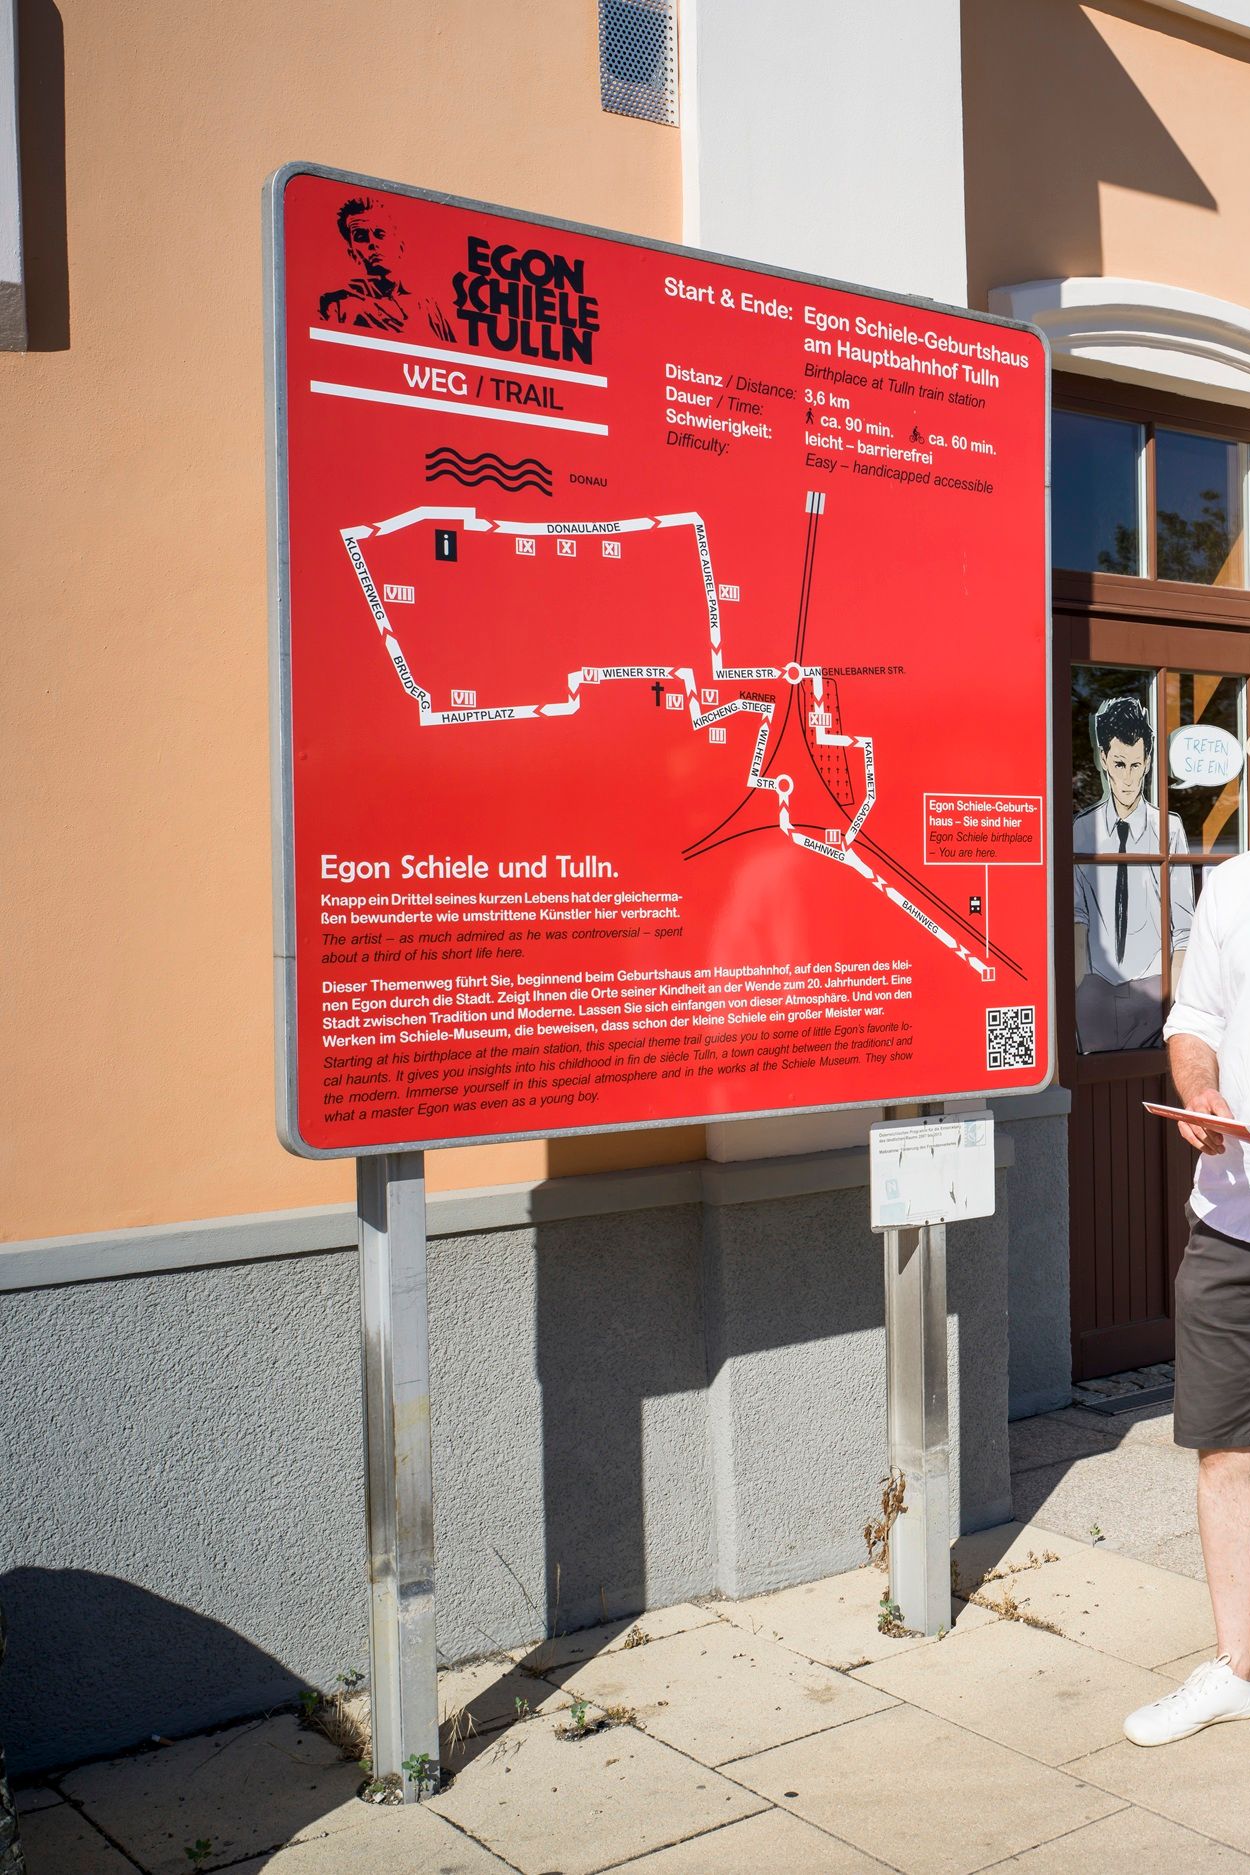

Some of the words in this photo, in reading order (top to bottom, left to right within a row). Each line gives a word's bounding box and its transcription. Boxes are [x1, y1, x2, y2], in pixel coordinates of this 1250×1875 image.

[468, 235, 584, 293] EGON
[452, 271, 600, 332] SCHIELE
[664, 276, 715, 304] Start
[720, 288, 735, 308] &
[741, 292, 792, 320] Ende:
[457, 308, 592, 366] TULLN
[804, 305, 849, 331] Egon
[855, 316, 1029, 368] Schiele-Geburtshaus
[803, 337, 831, 355] am
[837, 340, 959, 379] Hauptbahnhof
[961, 364, 999, 388] Tulln
[403, 363, 468, 396] WEG
[490, 378, 564, 410] TRAIL
[665, 363, 723, 387] Distanz
[735, 376, 796, 399] Distance:
[804, 362, 867, 387] Birthplace
[871, 377, 883, 390] at
[888, 378, 915, 396] Tulln
[918, 385, 944, 401] train
[947, 391, 985, 408] station
[666, 385, 713, 407] Dauer
[728, 396, 762, 415] Time:
[804, 388, 825, 406] 3,6
[829, 392, 850, 409] km
[666, 408, 772, 439] Schwierigkeit:
[820, 415, 841, 429] ca.
[845, 416, 862, 432] 90
[866, 422, 893, 438] min.
[666, 430, 729, 456] Difficulty:
[805, 431, 843, 450] leicht
[857, 439, 932, 464] barrierefrei
[928, 434, 947, 447] ca.
[951, 435, 967, 450] 60
[970, 440, 996, 455] min.
[569, 473, 608, 488] DONAU
[805, 452, 837, 473] Easy
[853, 460, 931, 484] handicapped
[933, 475, 993, 494] accessible
[344, 536, 385, 621] KLOSTERWEG
[602, 668, 643, 678] WIENER
[646, 667, 669, 678] STR.
[716, 669, 753, 679] WIENER
[756, 669, 777, 678] STR.
[887, 666, 906, 675] STR.
[739, 690, 776, 703] KARNER
[741, 701, 772, 714] STIEGE
[441, 709, 515, 724] HAUPTPLATZ
[693, 702, 740, 729] KIRCHENG.
[751, 729, 769, 777] WILHELM
[1184, 737, 1230, 757] TRETEN
[1184, 757, 1204, 773] SIE
[1207, 759, 1229, 777] EIN!
[756, 779, 777, 790] STR.
[929, 799, 954, 813] Egon
[956, 800, 1037, 812] Schiele-Geburts-
[929, 815, 953, 826] haus
[963, 815, 978, 826] Sie
[980, 816, 1000, 827] sind
[1003, 817, 1022, 827] hier
[804, 837, 846, 862] BAHNWEG
[929, 831, 953, 844] Egon
[956, 831, 988, 842] Schiele
[990, 832, 1032, 844] birthplace
[939, 847, 956, 857] You
[958, 849, 973, 857] are
[975, 847, 998, 858] here.
[321, 854, 390, 883] Egon
[401, 854, 489, 879] Schiele
[498, 854, 546, 878] und
[555, 855, 618, 878] Tulln.
[321, 894, 366, 908] Knapp
[368, 893, 389, 905] ein
[391, 893, 432, 905] Drittel
[434, 893, 477, 905] seines
[479, 892, 522, 904] kurzen
[524, 892, 569, 903] Lebens
[571, 892, 591, 903] hat
[591, 891, 613, 903] der
[613, 891, 682, 905] gleicherma-
[321, 912, 346, 924] ßen
[350, 911, 433, 924] bewunderte
[436, 910, 459, 922] wie
[463, 909, 536, 921] umstrittene
[540, 908, 592, 920] Künstler
[594, 908, 618, 919] hier
[620, 907, 680, 918] verbracht.
[902, 899, 939, 935] BAHNWEG
[321, 933, 346, 945] The
[350, 933, 382, 945] artist
[399, 934, 414, 944] as
[418, 931, 452, 943] much
[456, 930, 505, 942] admired
[508, 931, 522, 941] as
[526, 929, 541, 940] he
[545, 931, 567, 940] was
[572, 927, 640, 939] controversial
[654, 926, 684, 939] spent
[321, 951, 358, 964] about
[361, 953, 369, 962] a
[373, 950, 401, 962] third
[404, 949, 417, 961] of
[420, 949, 437, 960] his
[441, 948, 472, 960] short
[475, 947, 492, 958] life
[496, 947, 525, 957] here.
[322, 981, 367, 993] Dieser
[370, 979, 452, 991] Themenweg
[455, 975, 488, 987] führt
[490, 974, 514, 987] Sie,
[517, 972, 582, 987] beginnend
[585, 971, 614, 982] beim
[617, 968, 691, 981] Geburtshaus
[694, 969, 711, 978] am
[714, 963, 792, 979] Hauptbahnhof,
[794, 963, 811, 974] auf
[812, 962, 832, 973] den
[834, 962, 870, 974] Spuren
[872, 960, 890, 971] des
[892, 959, 912, 970] klei-
